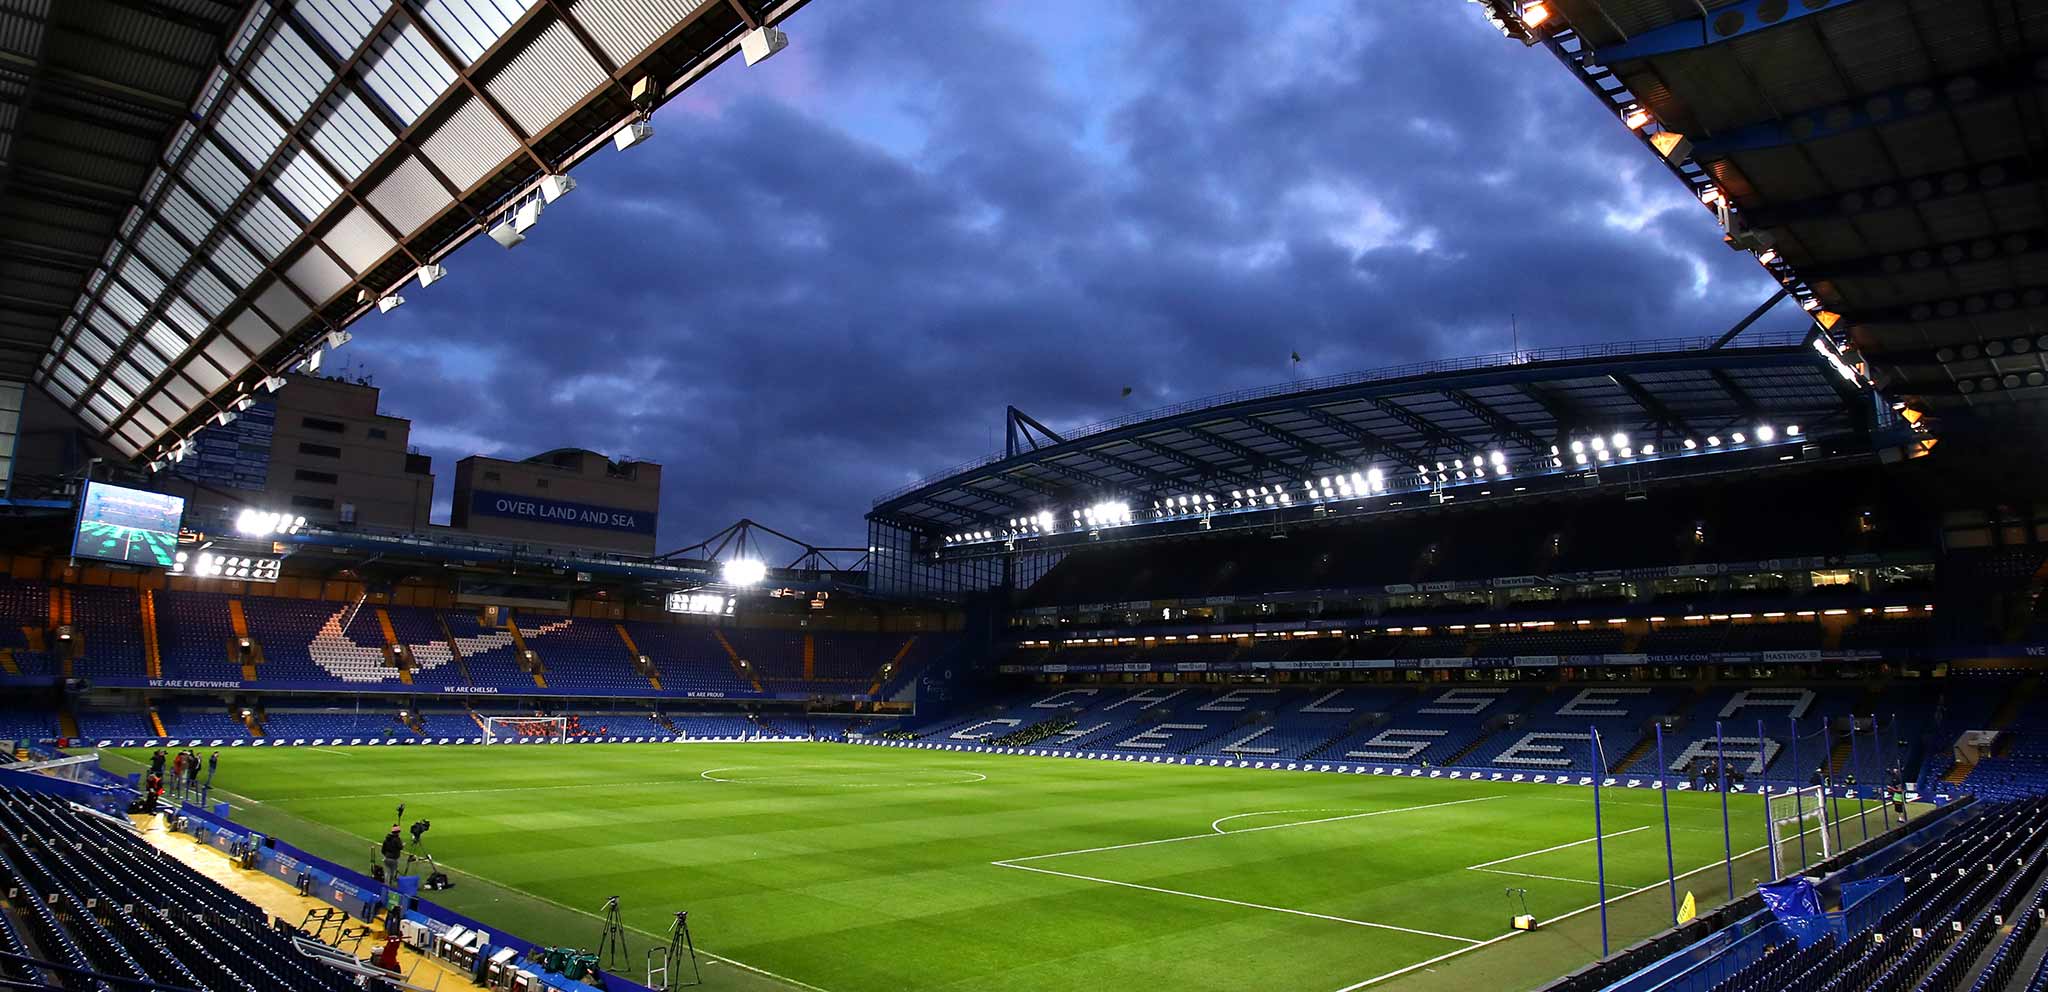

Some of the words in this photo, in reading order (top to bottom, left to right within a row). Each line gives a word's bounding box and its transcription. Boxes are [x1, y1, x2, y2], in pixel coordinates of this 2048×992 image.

[495, 499, 535, 516] OVER
[539, 505, 577, 520] LAND
[579, 510, 608, 524] AND
[611, 514, 635, 527] SEA
[2026, 646, 2046, 656] WE
[150, 679, 163, 687] WE
[184, 680, 240, 688] EVERYWHERE
[1031, 687, 1816, 717] CHELSEA
